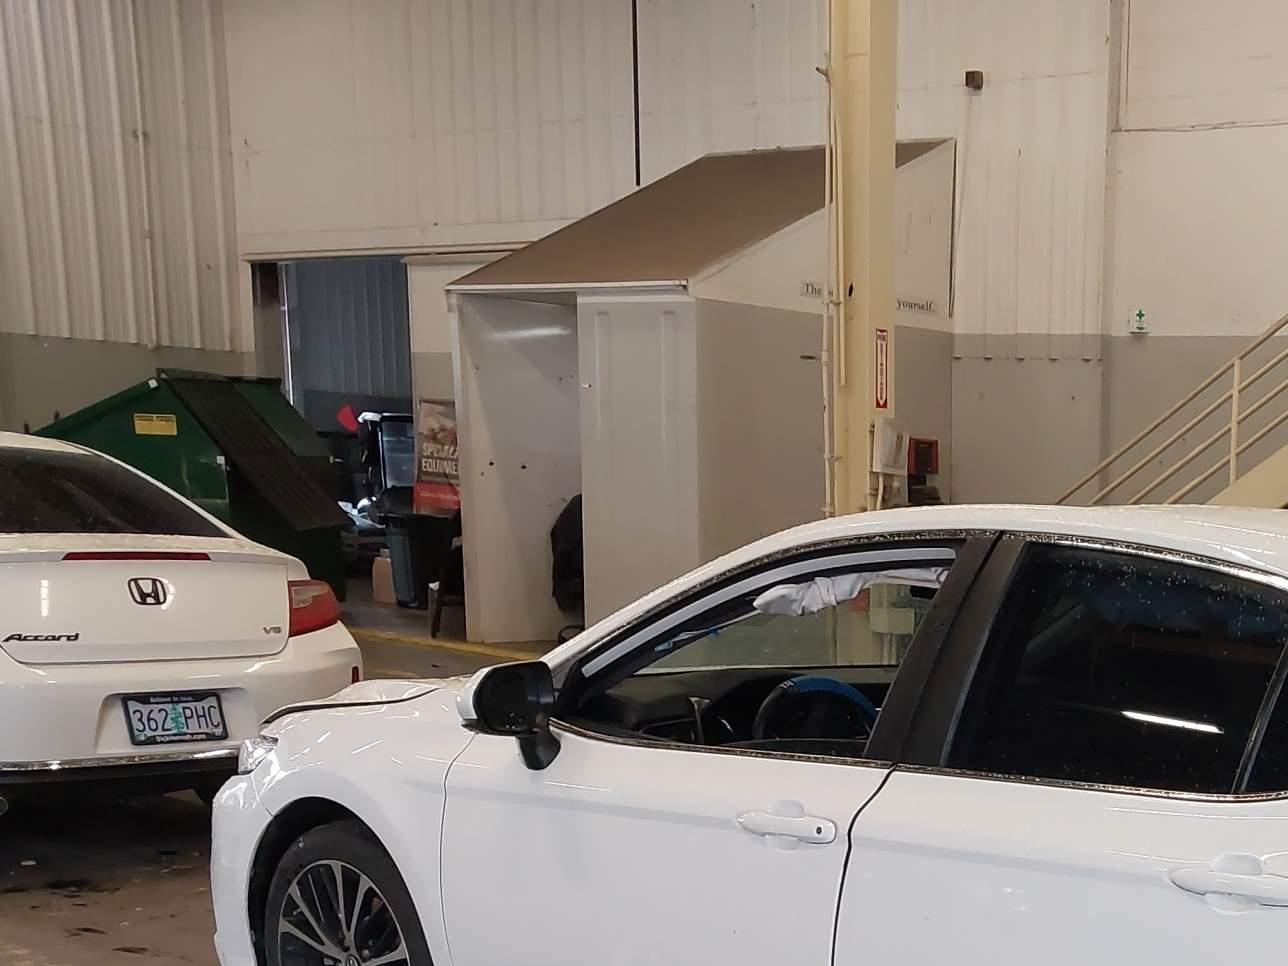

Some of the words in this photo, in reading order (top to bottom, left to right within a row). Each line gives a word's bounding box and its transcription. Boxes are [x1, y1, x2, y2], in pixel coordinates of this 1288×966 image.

[2, 632, 80, 642] Accord
[132, 707, 172, 733] 362
[181, 704, 221, 730] PHC
